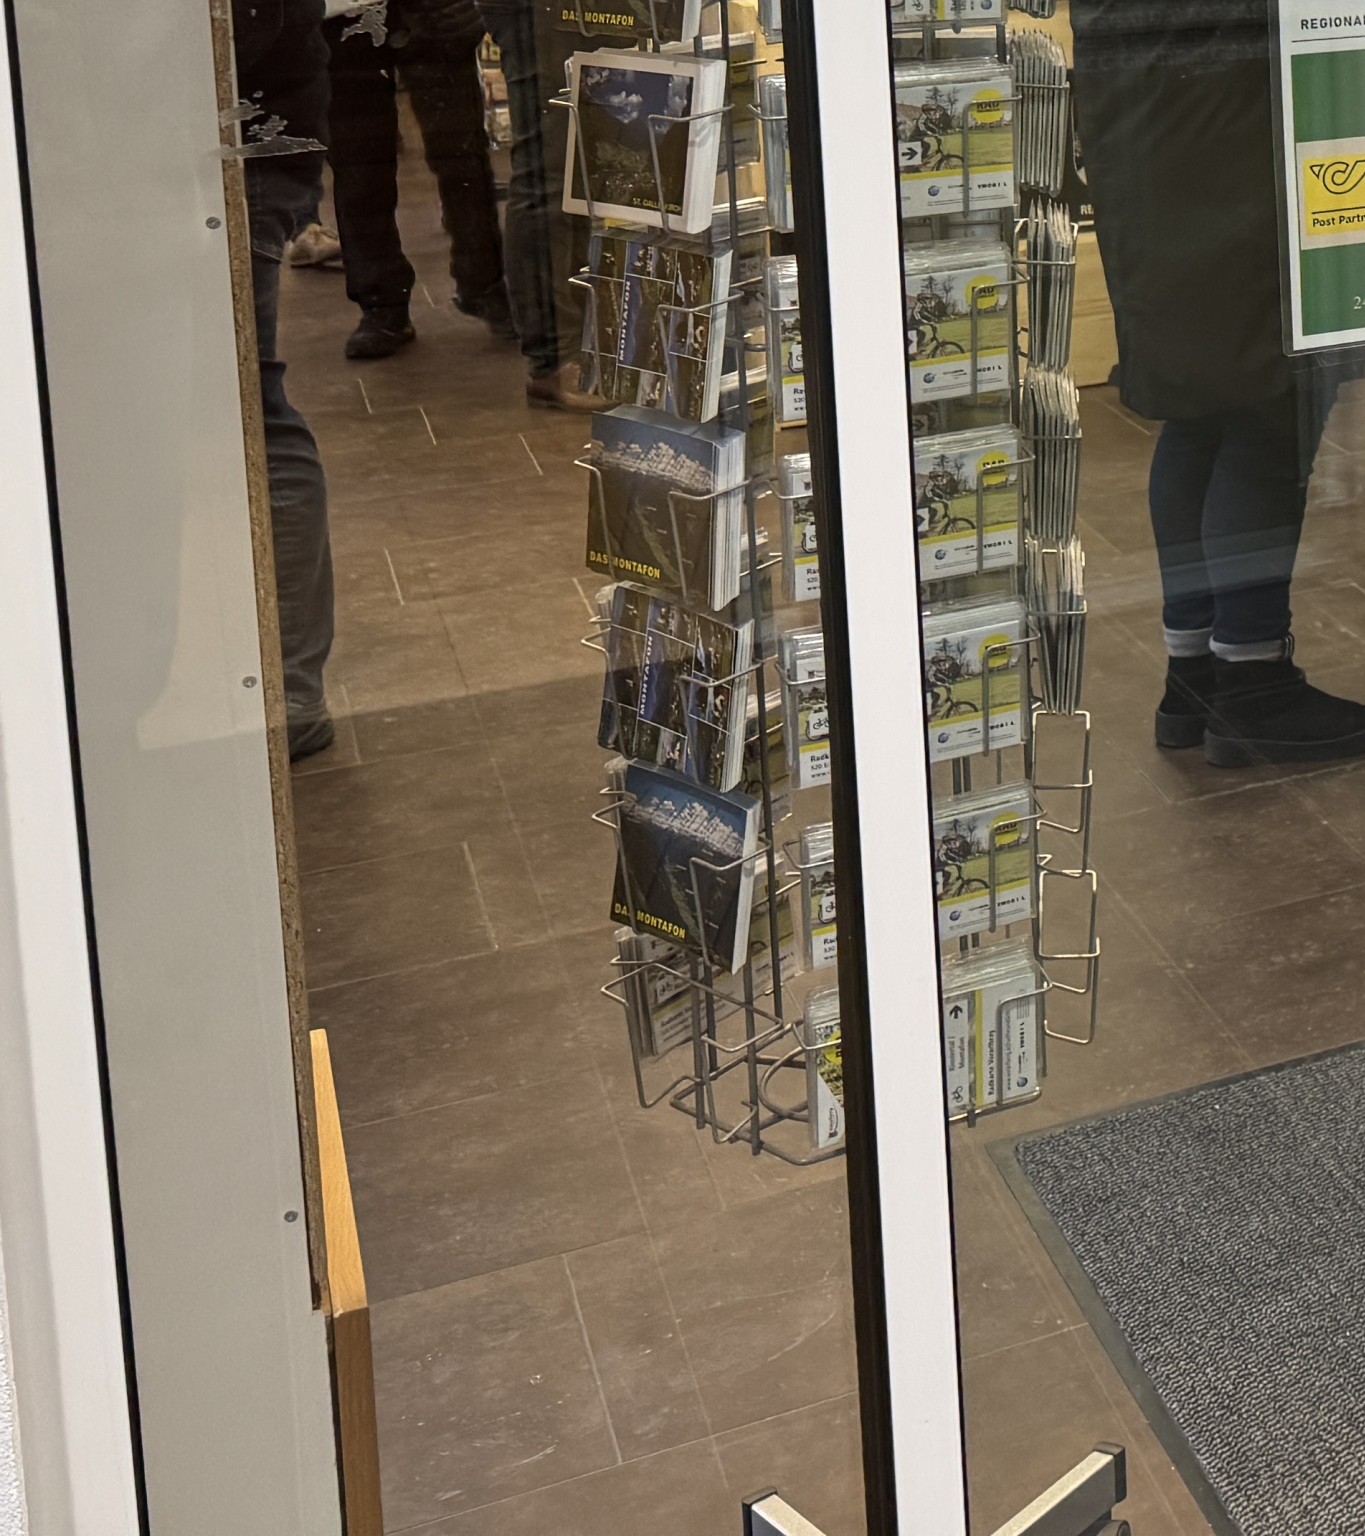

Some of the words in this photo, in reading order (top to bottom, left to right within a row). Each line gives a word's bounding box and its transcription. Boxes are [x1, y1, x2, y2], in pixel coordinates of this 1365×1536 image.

[585, 11, 634, 26] MONTAFON
[1312, 215, 1336, 228] Post
[590, 551, 608, 564] DAS
[611, 557, 661, 579] MONTAFON
[615, 904, 631, 917] DA
[637, 912, 686, 939] MONTAFON
